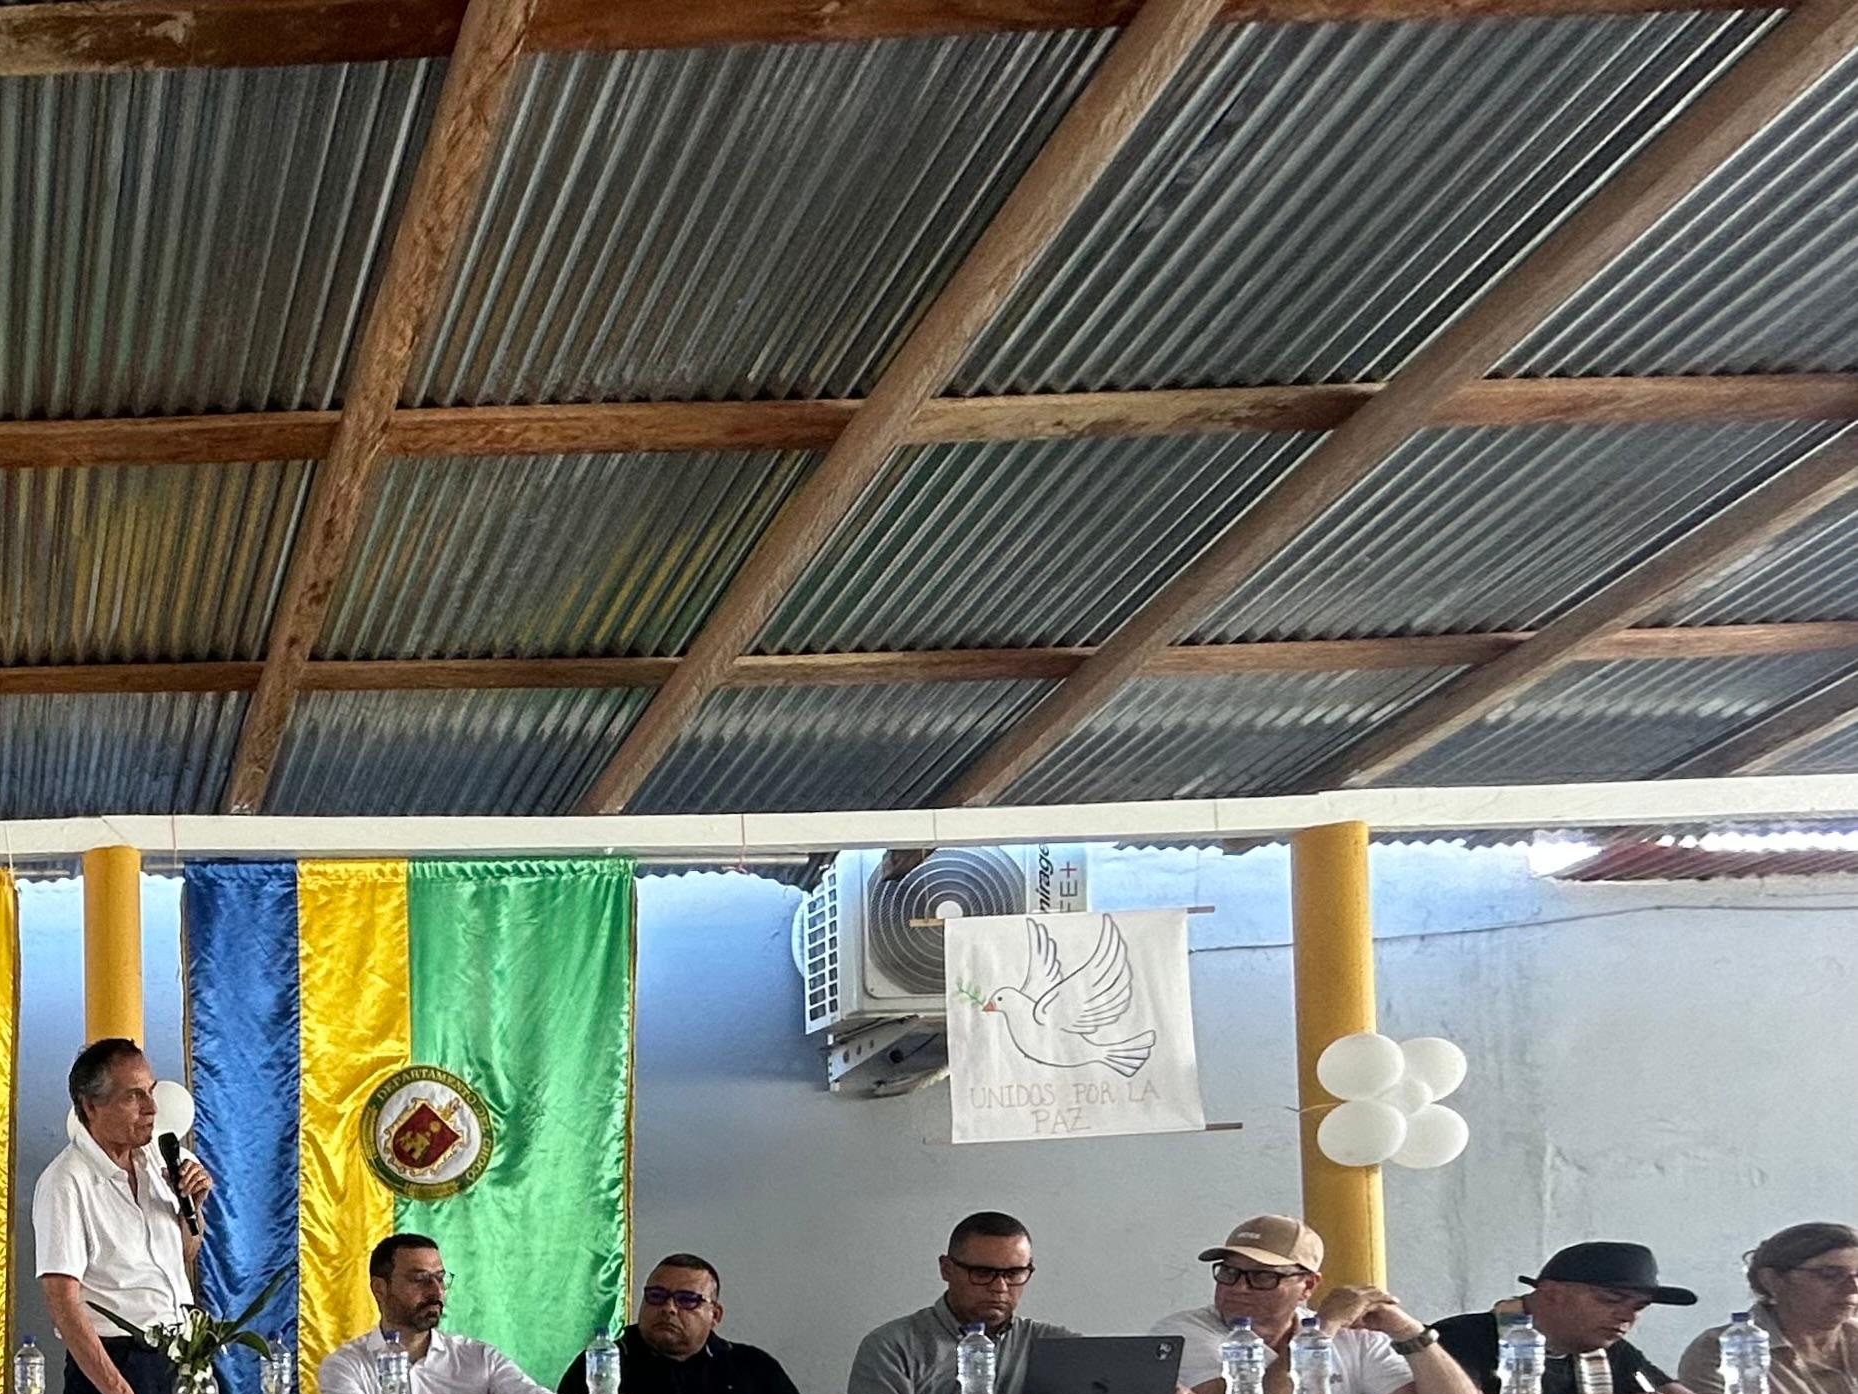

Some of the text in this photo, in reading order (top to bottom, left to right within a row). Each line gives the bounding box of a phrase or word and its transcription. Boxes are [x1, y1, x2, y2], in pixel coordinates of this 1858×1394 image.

[376, 1069, 478, 1104] DEPARTAMENTO
[970, 1080, 1161, 1109] UNIDOS POR LA
[1031, 1107, 1091, 1134] PAZ
